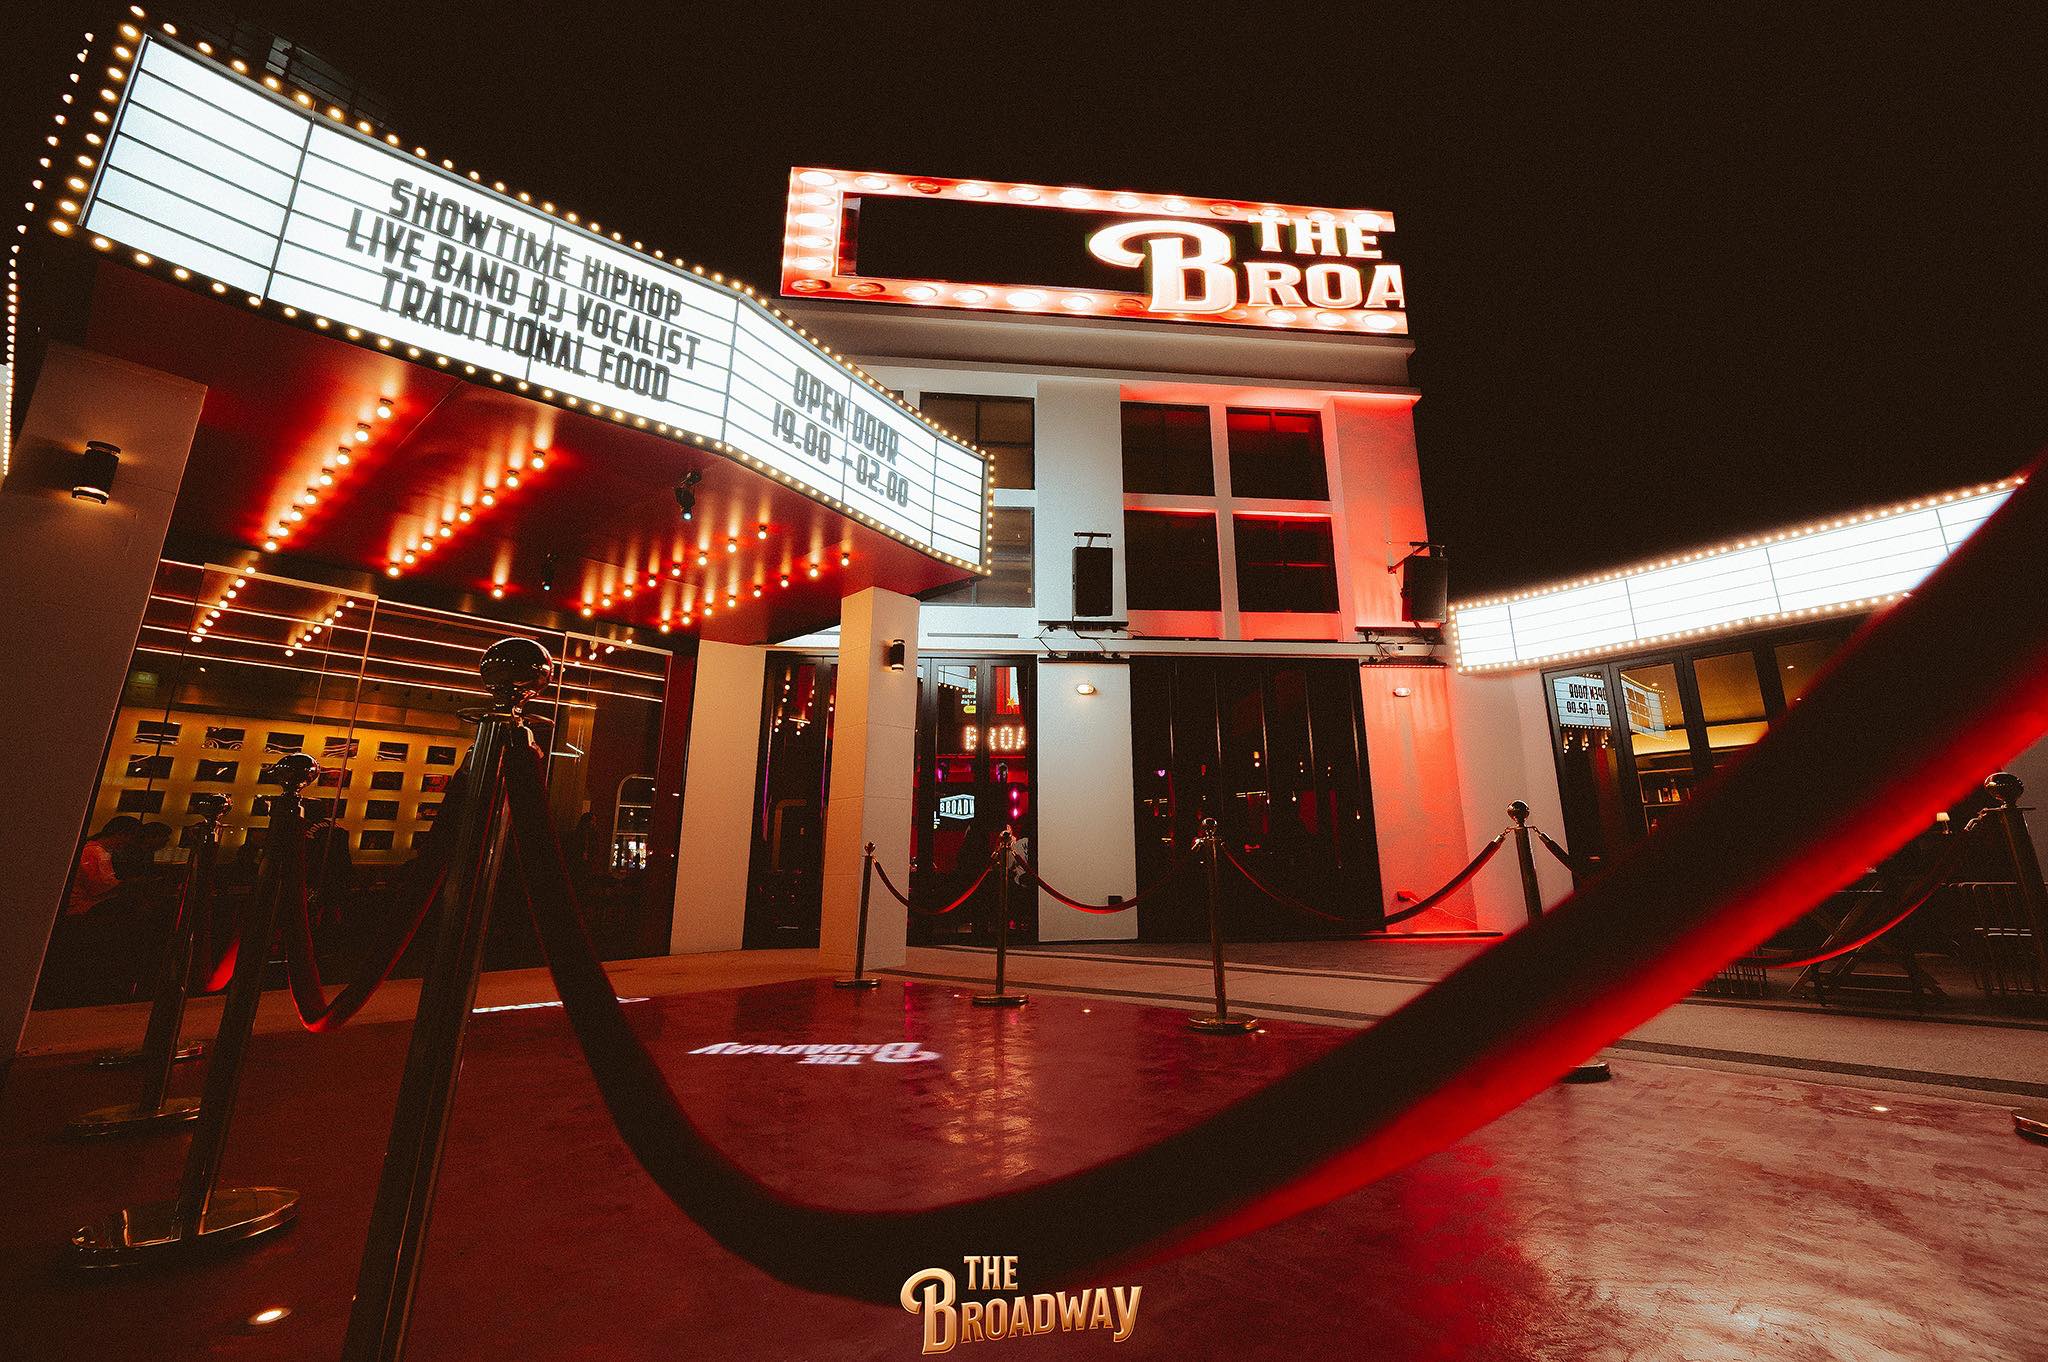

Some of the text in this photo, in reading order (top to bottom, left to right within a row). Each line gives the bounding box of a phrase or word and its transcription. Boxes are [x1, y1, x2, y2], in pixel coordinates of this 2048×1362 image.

[389, 178, 683, 322] SHOWTIME HIPHOP
[1247, 214, 1383, 259] THE
[345, 207, 701, 370] LIVE BAND DJ VOCALIST
[380, 266, 670, 403] TRADITIONAL FOOD
[772, 402, 832, 465] 19.00
[856, 453, 909, 508] 02.00
[793, 366, 899, 466] OPEN DOOR
[687, 1042, 941, 1063] BROADWAY
[796, 1054, 862, 1065] THE
